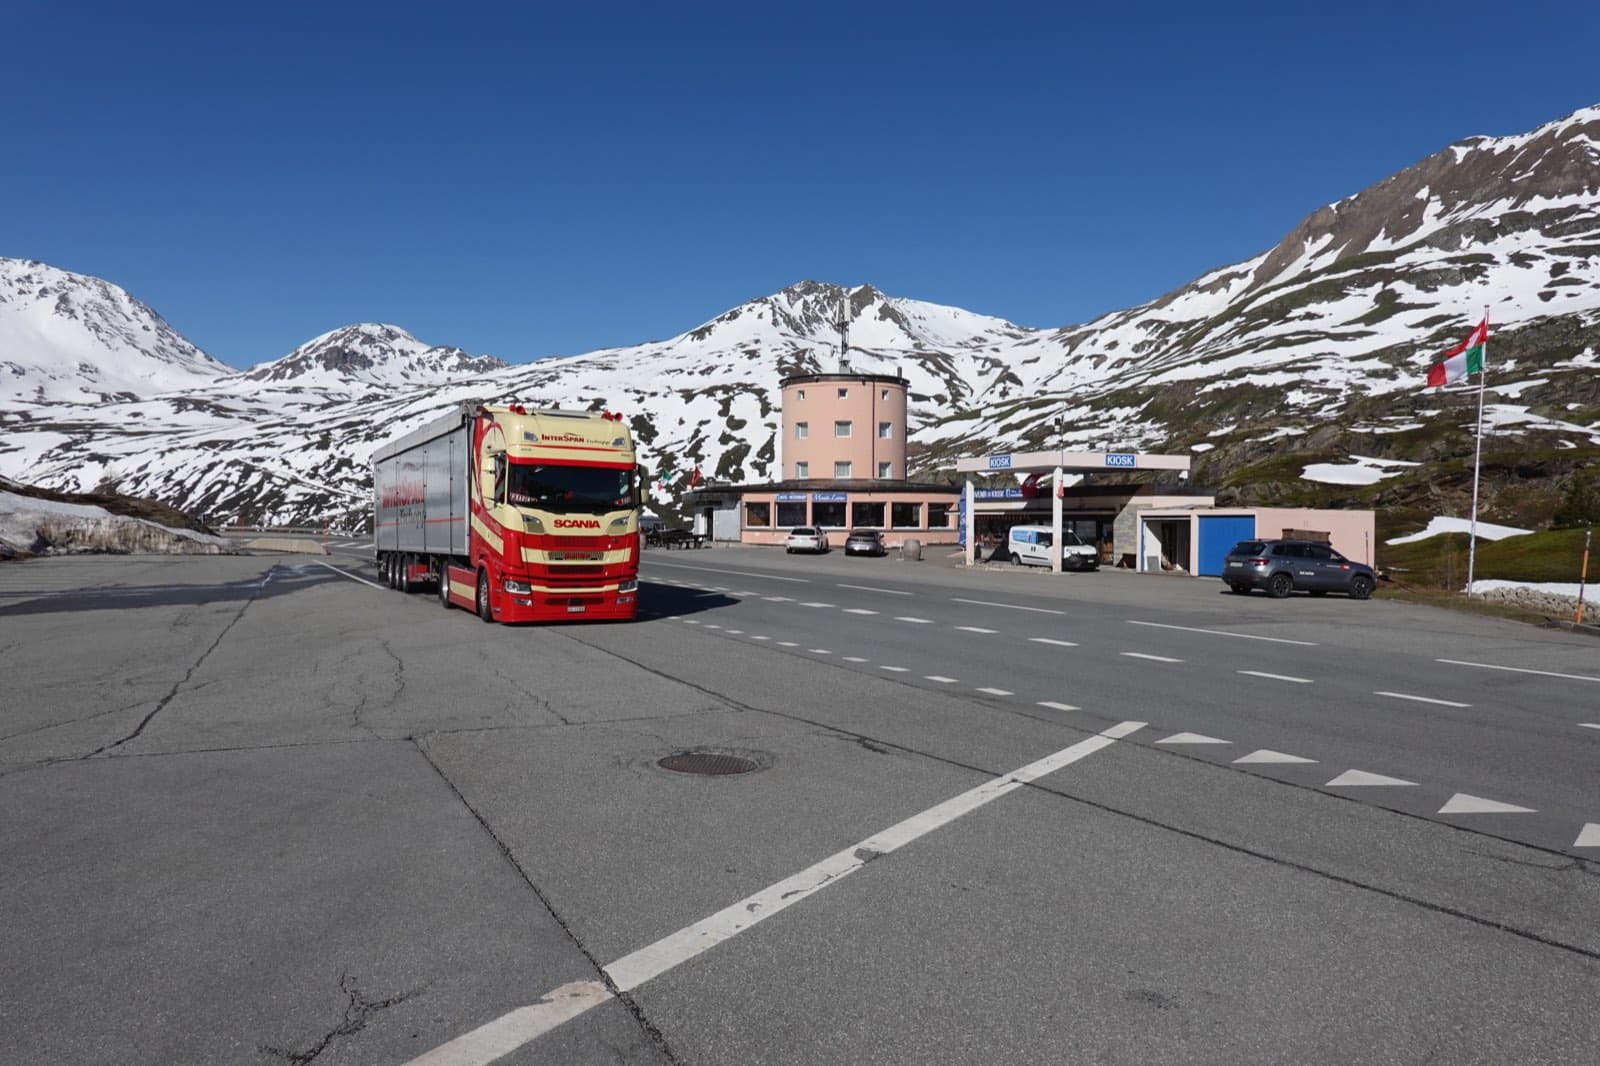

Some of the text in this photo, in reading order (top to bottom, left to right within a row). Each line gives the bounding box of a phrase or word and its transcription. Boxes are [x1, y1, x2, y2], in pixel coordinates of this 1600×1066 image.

[990, 457, 1010, 468] KIOSK
[1107, 456, 1133, 466] KIOSK
[553, 519, 600, 529] SCANIA
